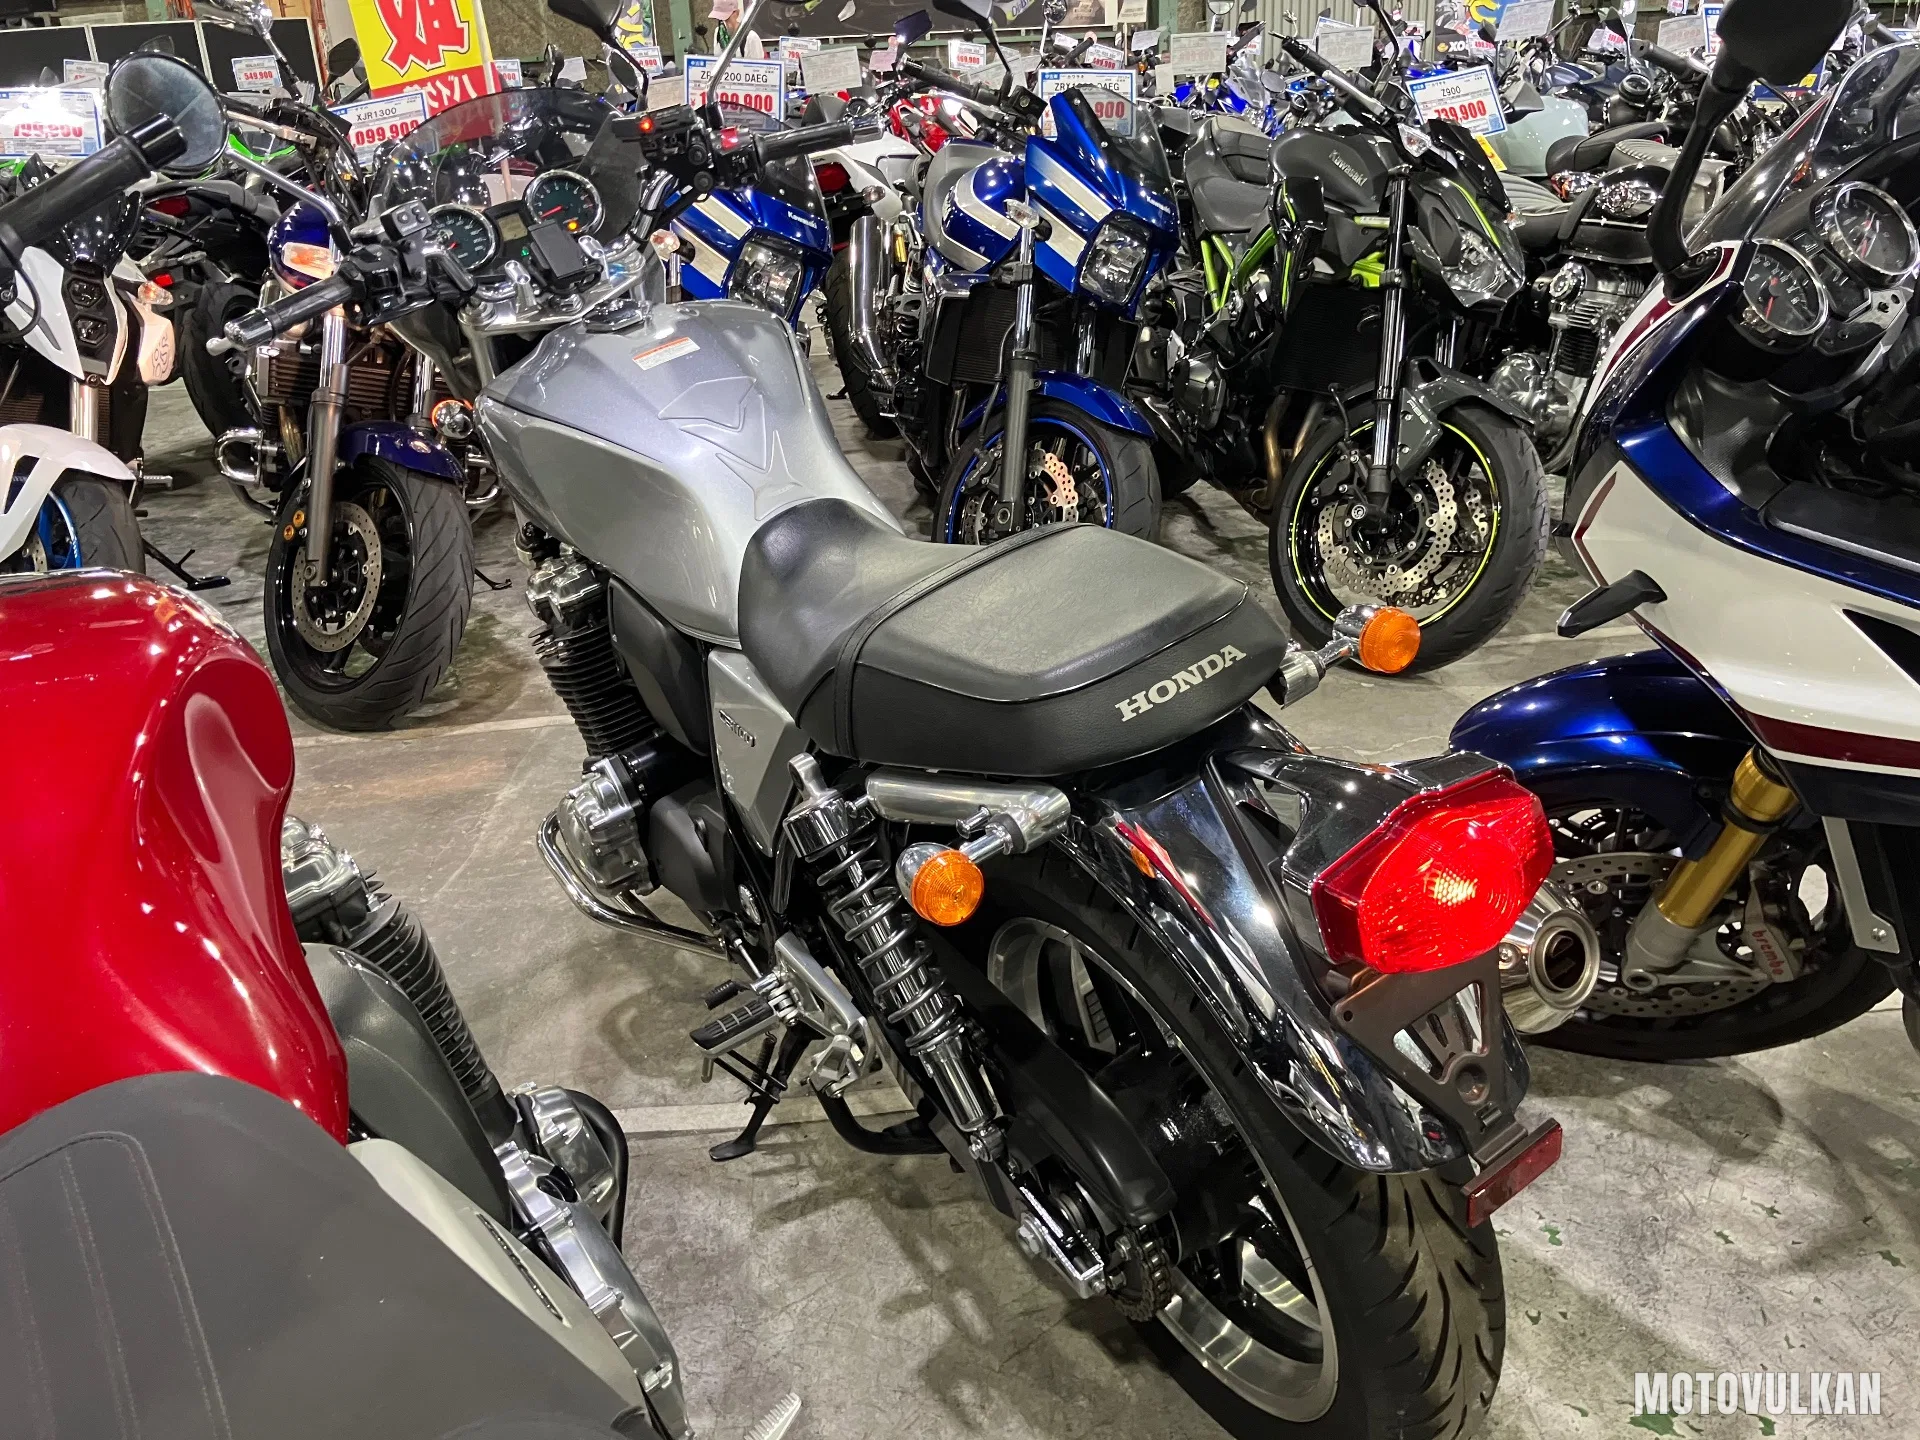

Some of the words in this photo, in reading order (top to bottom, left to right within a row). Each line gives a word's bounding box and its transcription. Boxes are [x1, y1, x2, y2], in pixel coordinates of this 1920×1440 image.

[744, 73, 768, 83] DAEG
[1440, 86, 1461, 97] Z900
[356, 107, 397, 122] XJR1300
[1328, 149, 1368, 187] Kawasaki
[1114, 644, 1247, 722] HONDA
[1751, 928, 1786, 976] brembo
